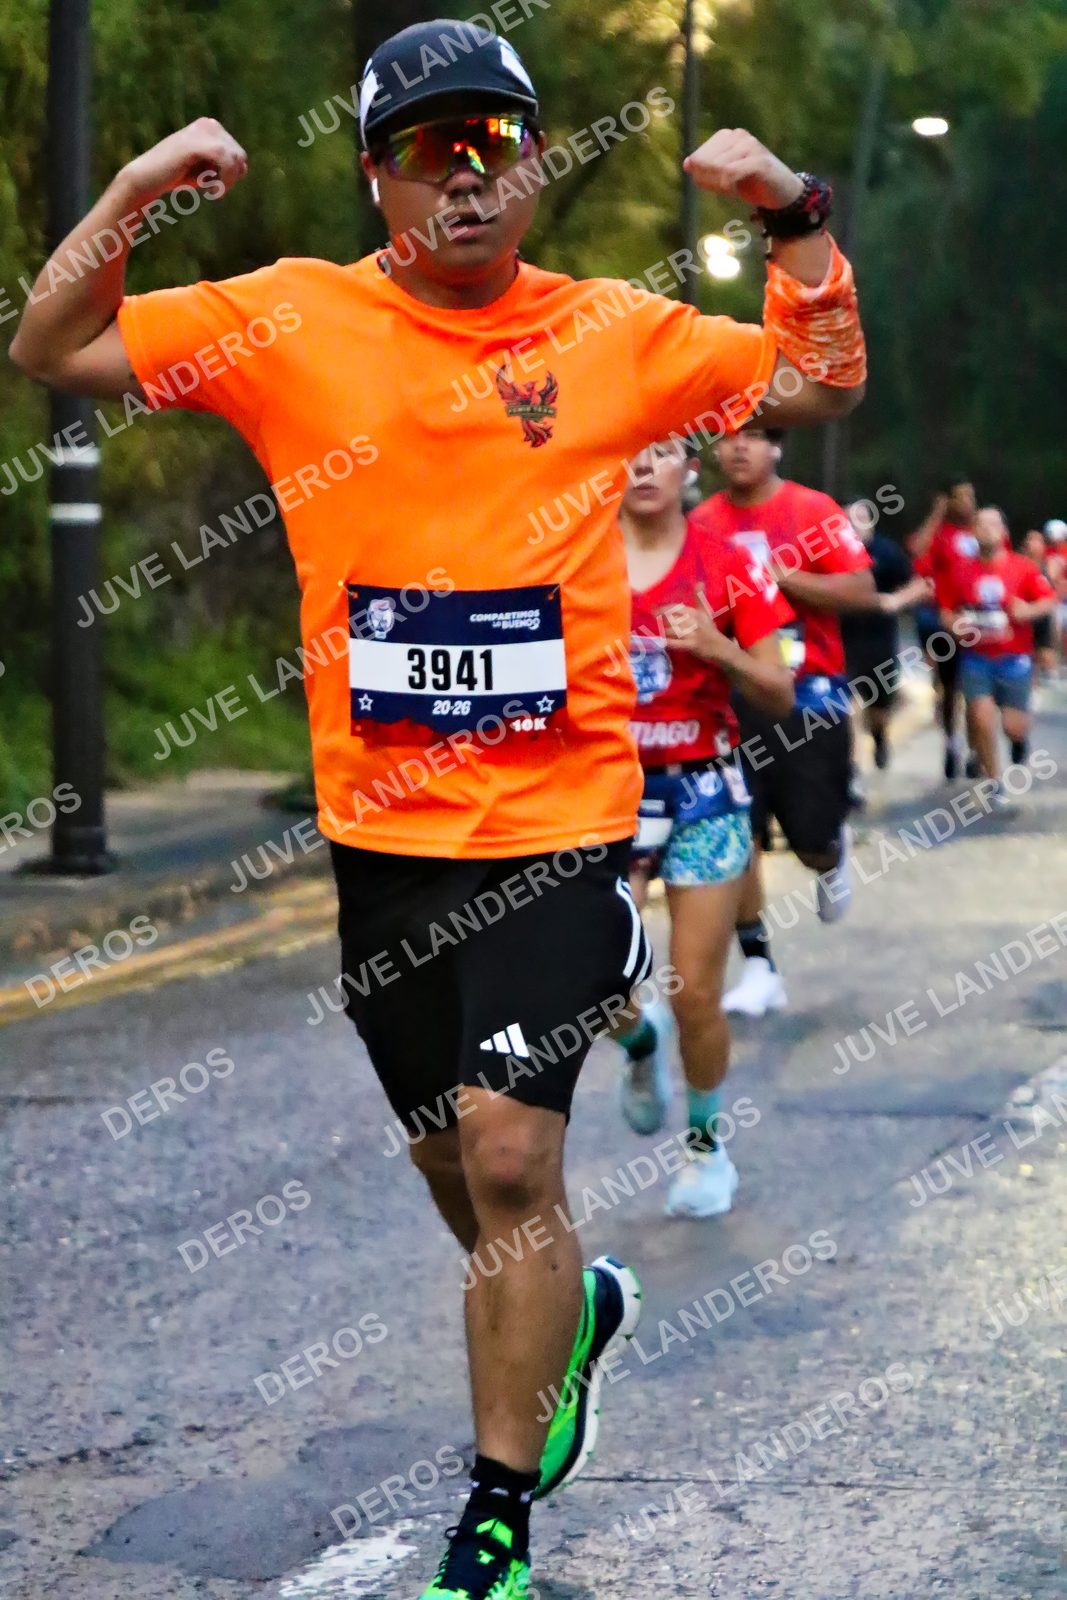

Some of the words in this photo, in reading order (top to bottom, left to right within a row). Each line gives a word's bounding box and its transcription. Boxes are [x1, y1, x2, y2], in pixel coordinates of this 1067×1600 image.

[469, 609, 540, 622] COMPARTIMOS
[407, 648, 493, 691] 3941
[510, 717, 547, 732] 10K
